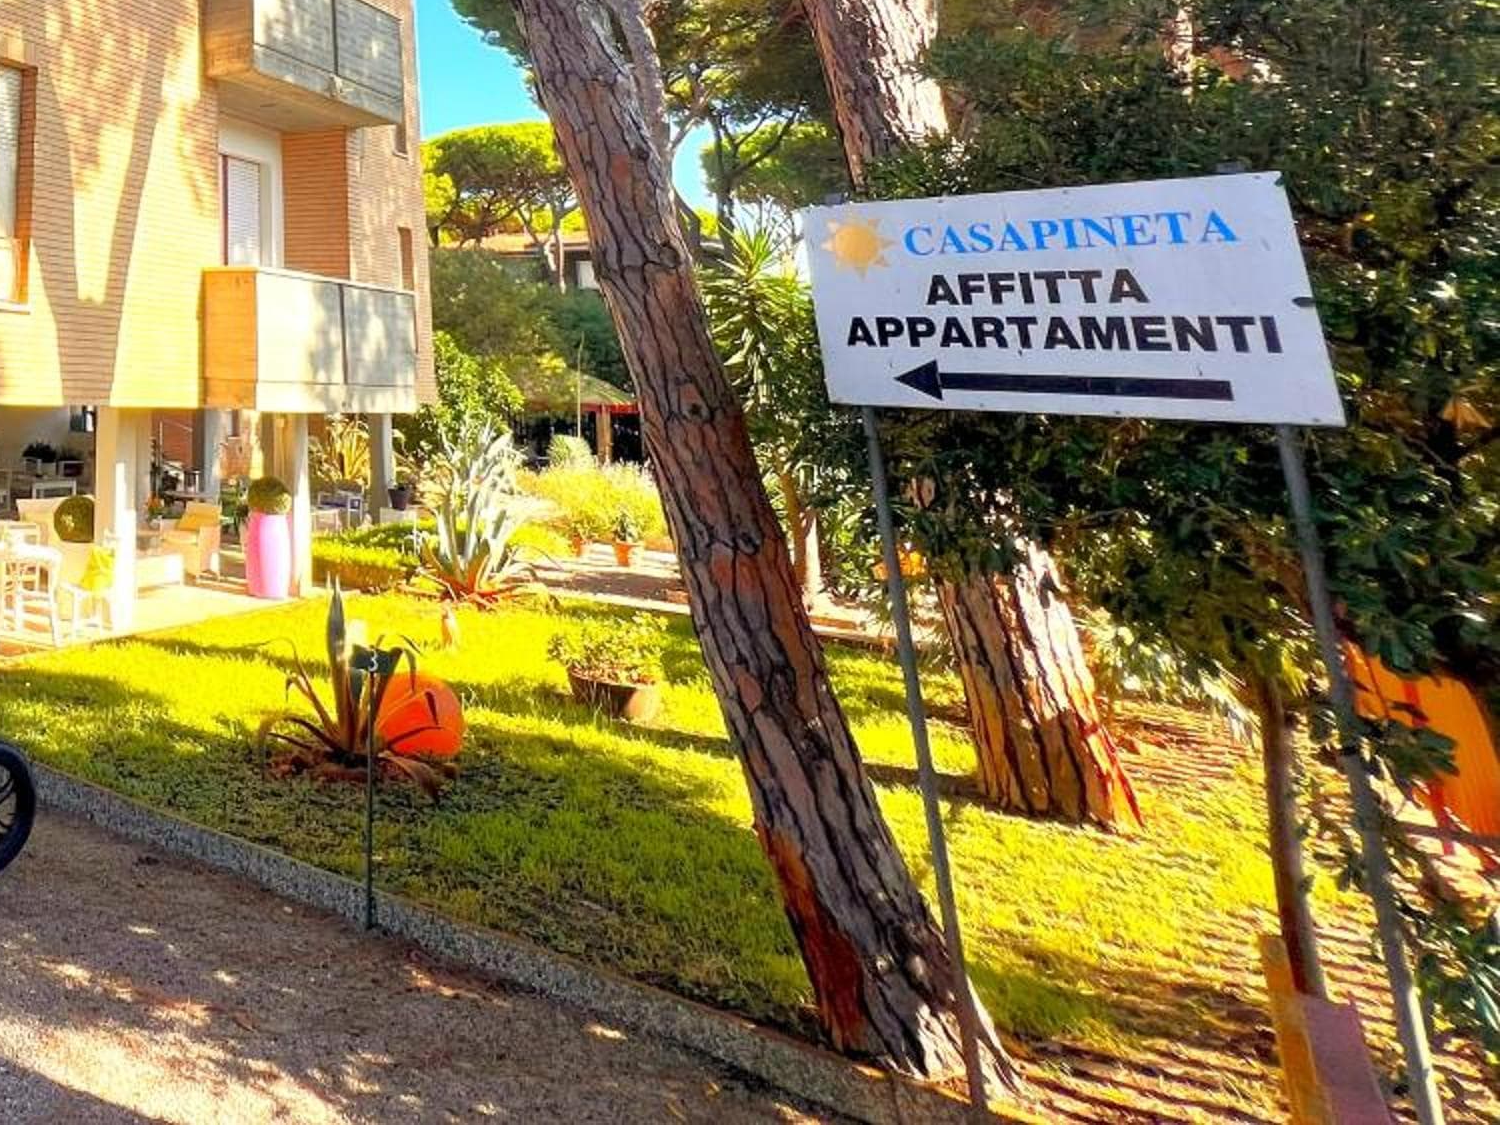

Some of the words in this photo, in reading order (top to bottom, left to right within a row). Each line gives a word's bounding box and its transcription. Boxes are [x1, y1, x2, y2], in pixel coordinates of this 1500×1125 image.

[903, 210, 1240, 257] CASAPINETA
[926, 269, 1150, 306] AFFITTA
[846, 315, 1284, 354] APPARTAMENTI
[368, 649, 379, 673] 3
